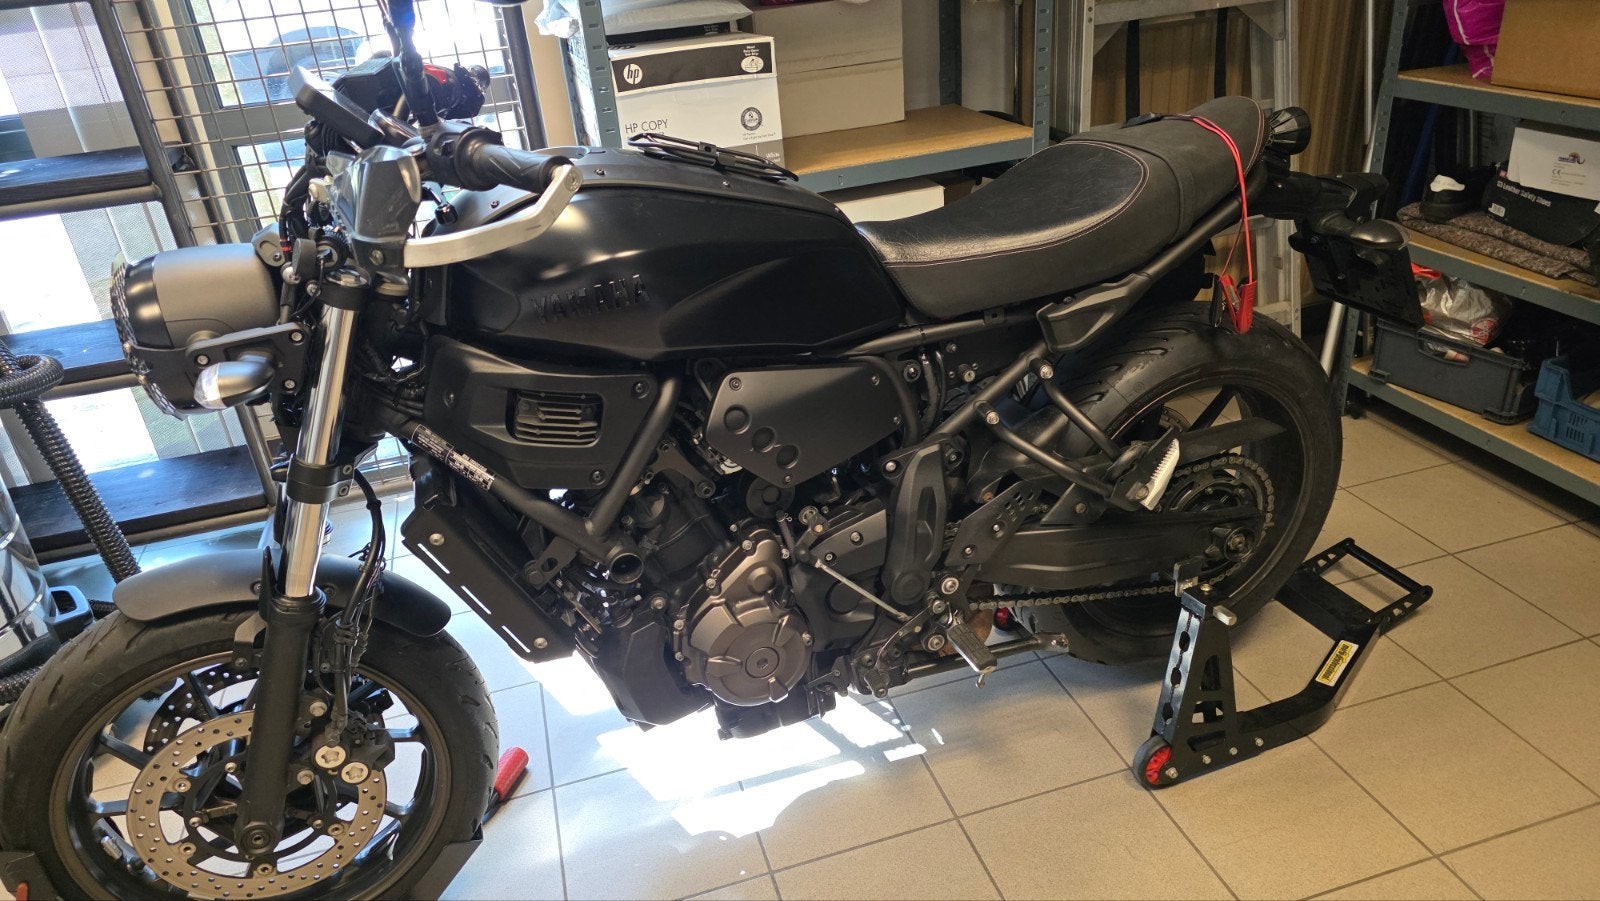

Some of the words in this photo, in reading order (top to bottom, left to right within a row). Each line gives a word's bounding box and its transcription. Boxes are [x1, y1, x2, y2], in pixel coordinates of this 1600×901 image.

[625, 123, 638, 134] HP
[641, 118, 669, 132] COPY
[1503, 182, 1520, 195] Leather
[1520, 190, 1536, 202] Safety
[1536, 196, 1551, 207] Shoes
[531, 274, 649, 322] YAMAHA
